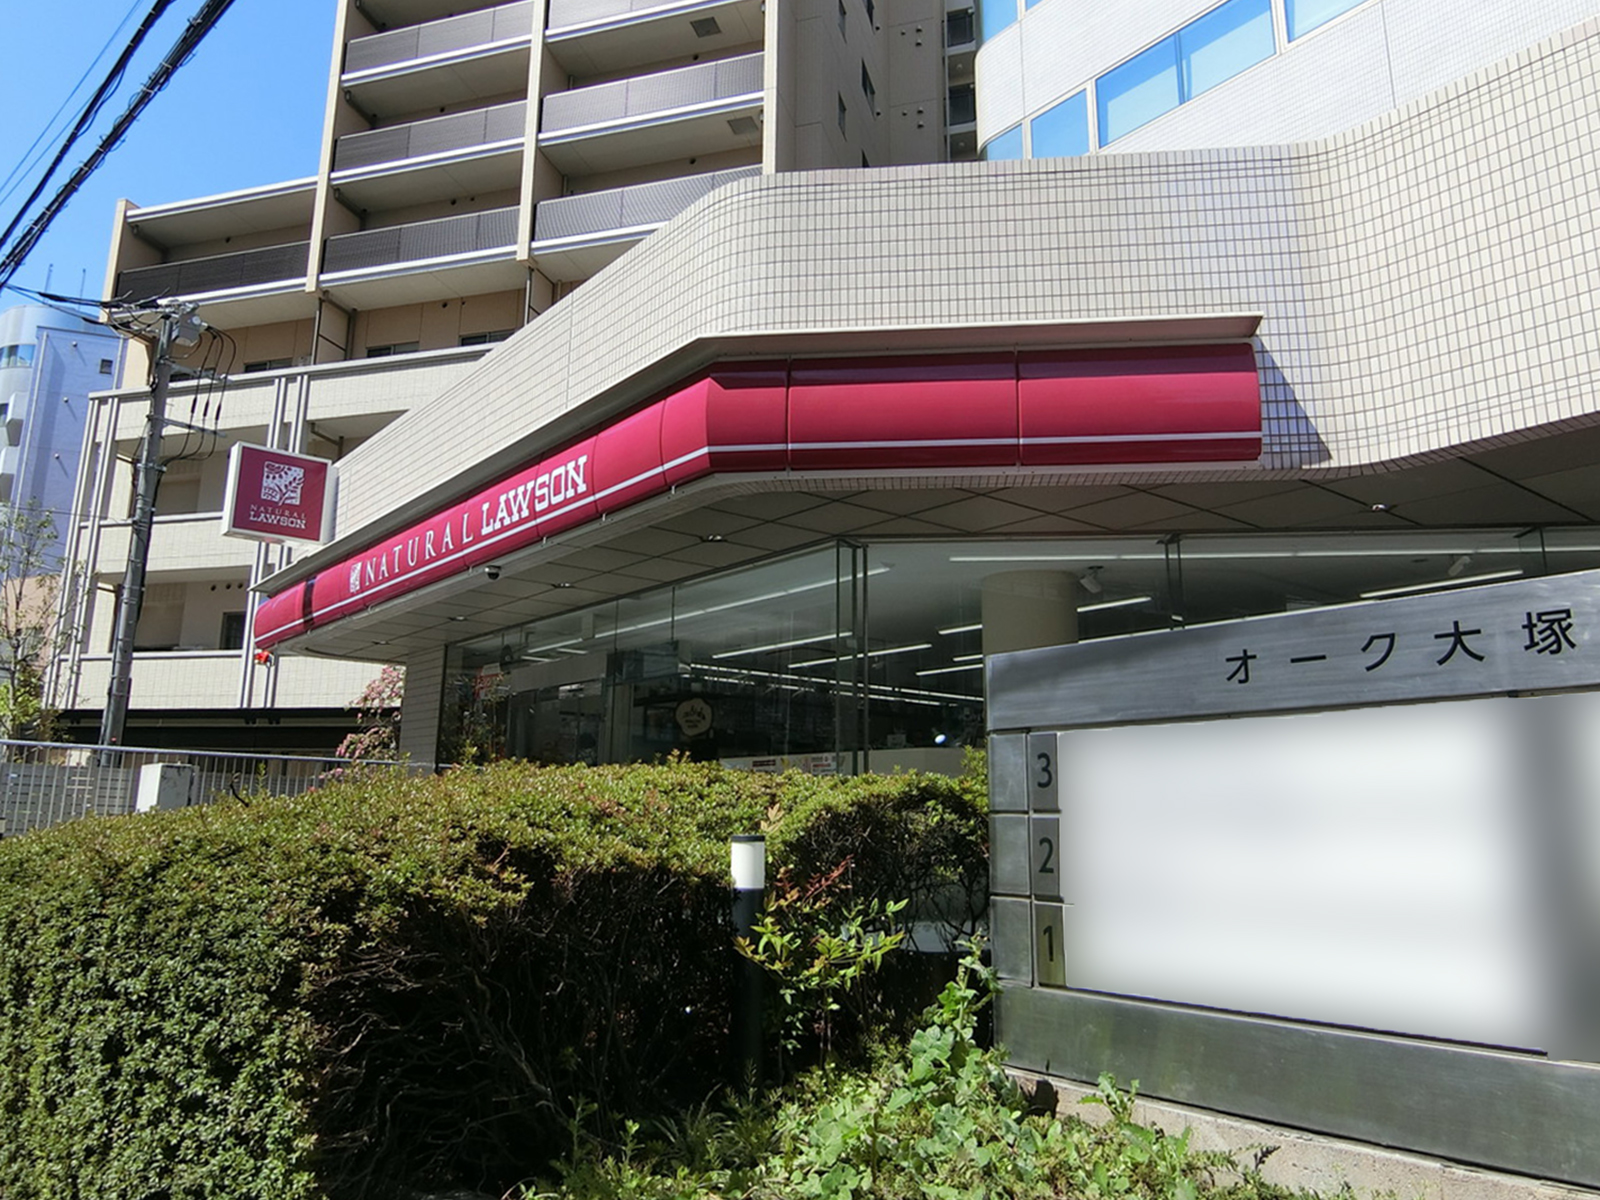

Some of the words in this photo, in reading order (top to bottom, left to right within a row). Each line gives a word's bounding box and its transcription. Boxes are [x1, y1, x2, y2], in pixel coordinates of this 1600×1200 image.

[249, 511, 307, 530] LAWSON
[250, 504, 307, 520] NATURAL
[365, 513, 474, 586] NATURAL
[481, 455, 588, 536] LAWSON
[1225, 608, 1577, 685] オーク大塚
[1036, 752, 1053, 789] 3
[1038, 836, 1055, 874] 2
[1042, 925, 1054, 963] 1
